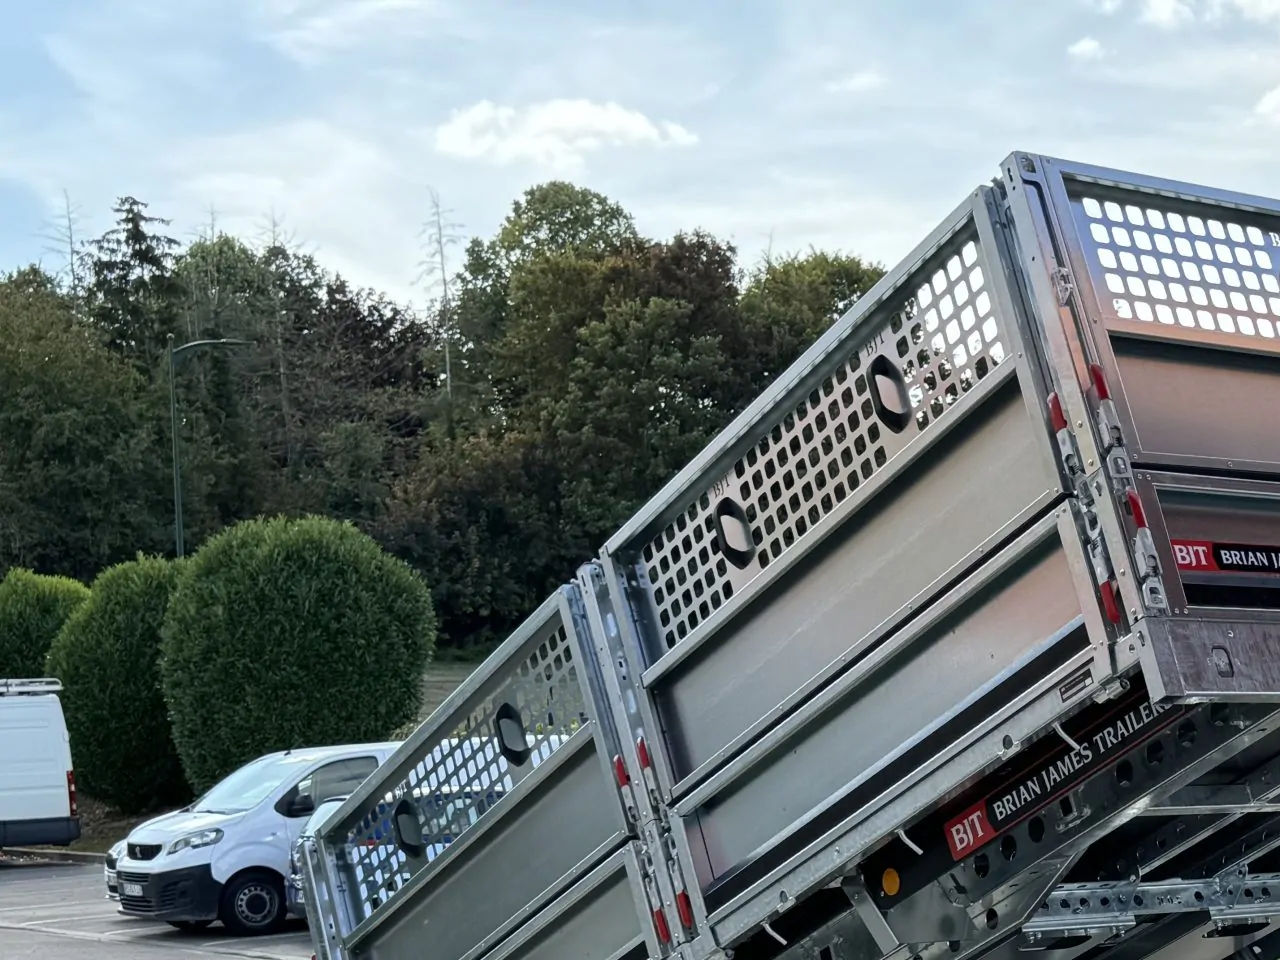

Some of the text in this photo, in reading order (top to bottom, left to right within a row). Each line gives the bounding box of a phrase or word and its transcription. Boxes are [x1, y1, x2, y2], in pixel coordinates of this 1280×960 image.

[1173, 544, 1208, 567] BJT
[1220, 550, 1269, 567] BRIAN
[951, 810, 984, 851] BJT
[992, 777, 1042, 821] BRIAN
[1041, 742, 1093, 792] JAMES
